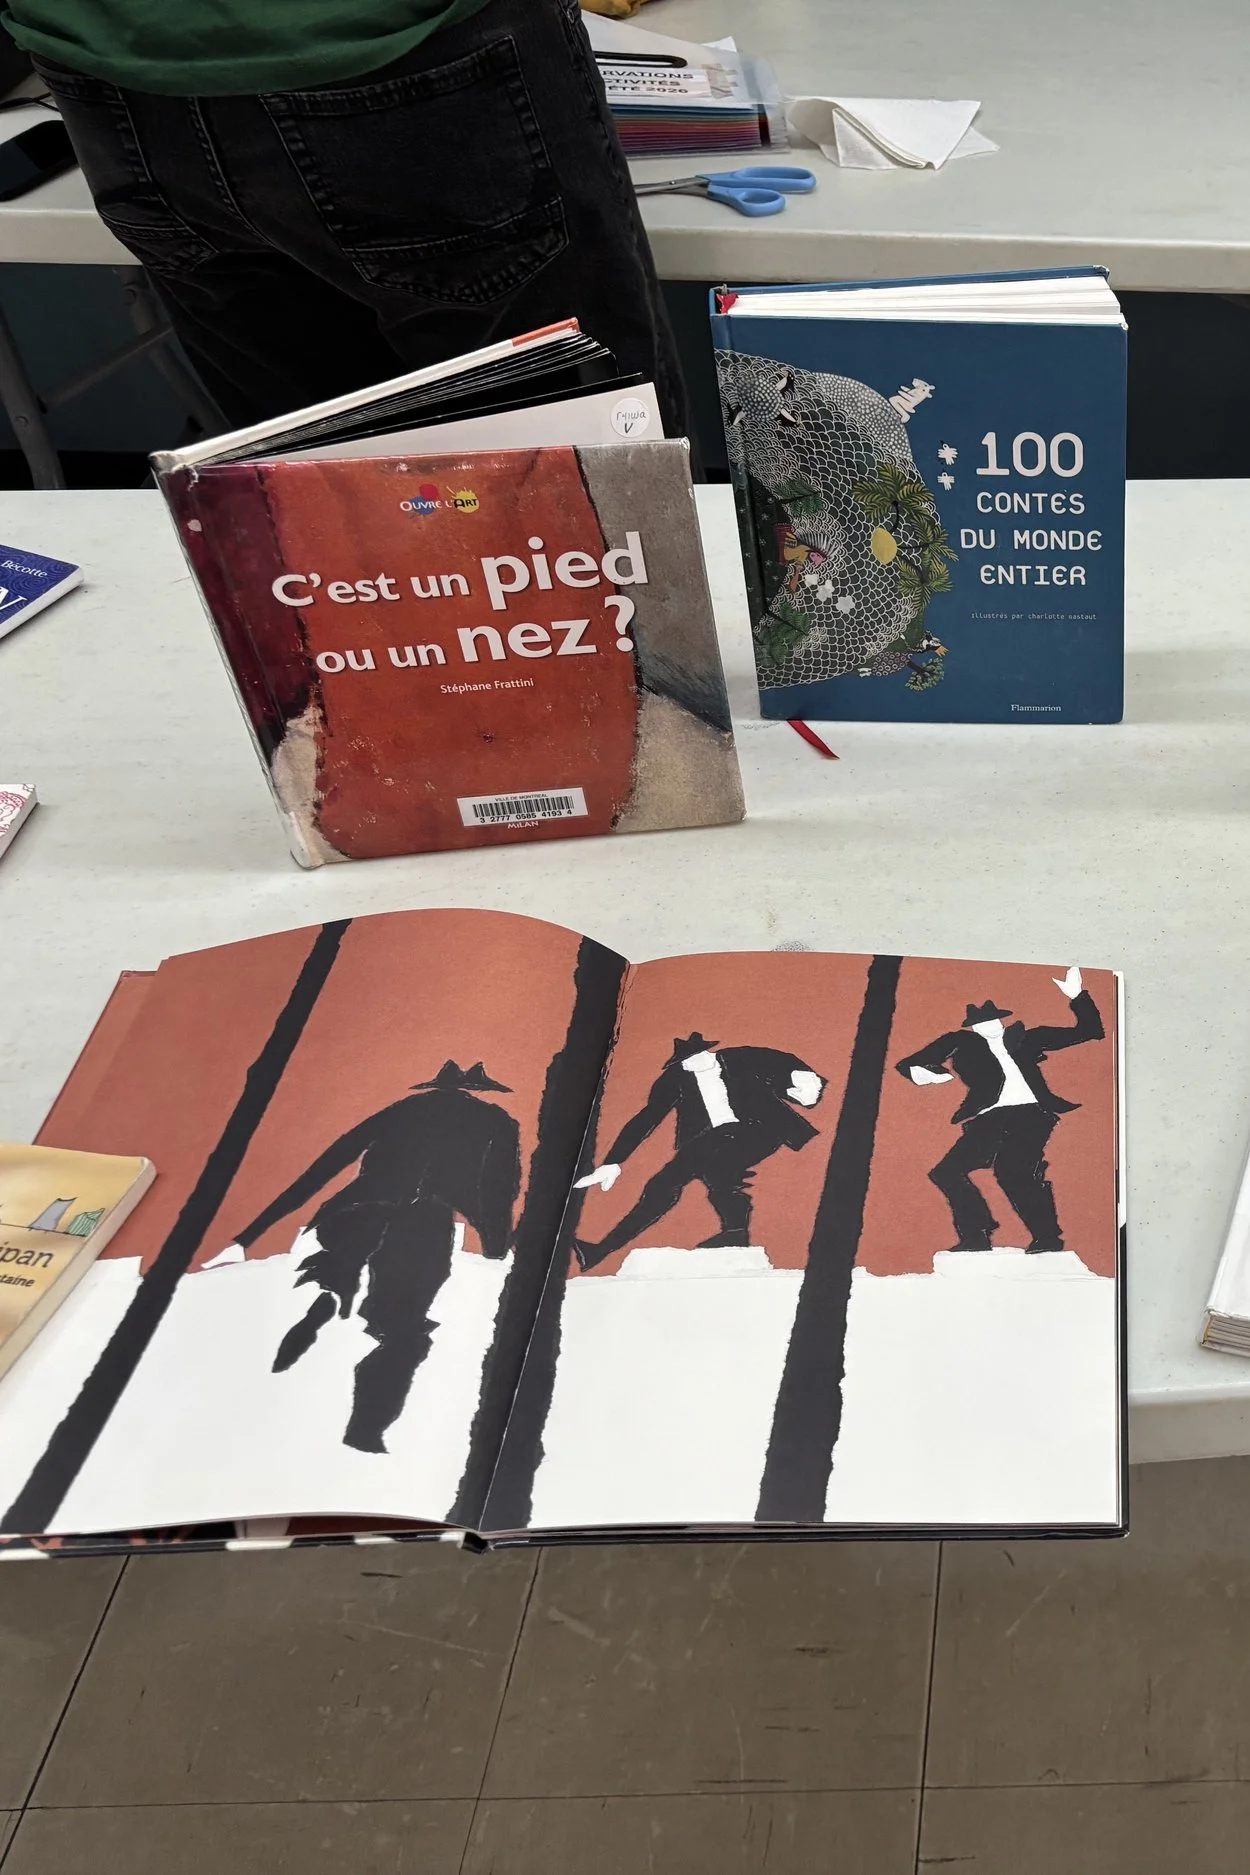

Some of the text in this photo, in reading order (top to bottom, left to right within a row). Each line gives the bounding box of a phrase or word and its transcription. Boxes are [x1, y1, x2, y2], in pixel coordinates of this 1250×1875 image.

[602, 70, 694, 79] RVATIONS
[605, 78, 681, 86] CTIVITÉS
[976, 431, 1084, 478] 100
[400, 500, 442, 511] OUVRE
[976, 491, 1085, 515] CONTES
[960, 528, 1103, 551] DU MONDE
[1, 559, 48, 578] Bécotte
[271, 531, 649, 611] C'est un pied
[980, 564, 1086, 586] ENTIER
[1028, 612, 1065, 620] charlotte
[315, 594, 636, 674] ou un nez ?
[440, 677, 535, 694] Stéphane Frattini
[1010, 704, 1062, 712] Flammarion
